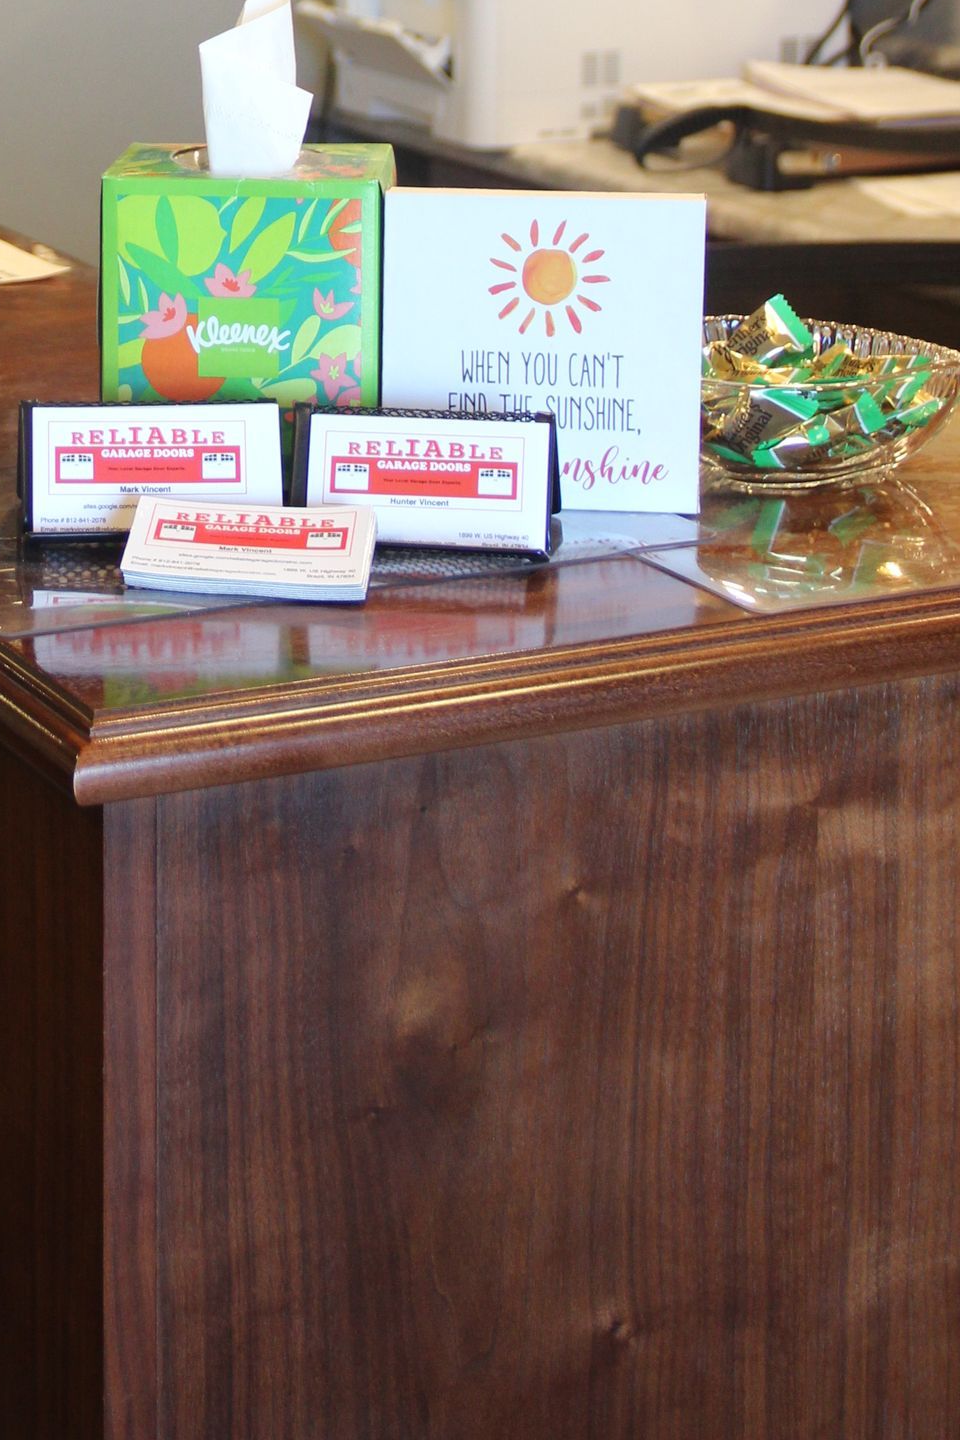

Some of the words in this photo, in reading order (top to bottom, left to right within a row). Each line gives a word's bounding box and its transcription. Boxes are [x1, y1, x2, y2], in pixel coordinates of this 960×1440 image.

[187, 315, 291, 354] Kleenex
[461, 350, 510, 385] WHEN
[521, 352, 558, 386] YOU
[568, 352, 624, 388] CAN'T
[546, 395, 641, 435] SUNSHINE,
[71, 427, 225, 445] RELIABLE
[101, 448, 151, 458] GARAGE
[153, 447, 194, 458] DOORS
[348, 439, 503, 460] RELIABLE
[377, 461, 427, 471] GARAGE
[430, 462, 471, 472] DOORS
[560, 445, 669, 490] nshine
[142, 485, 171, 493] Vincent
[390, 497, 417, 506] Hunter
[420, 498, 449, 507] Vincent
[176, 511, 335, 528] RELIABLE
[205, 523, 257, 533] GARAGE
[258, 527, 301, 535] DOORS
[494, 533, 520, 542] Highway
